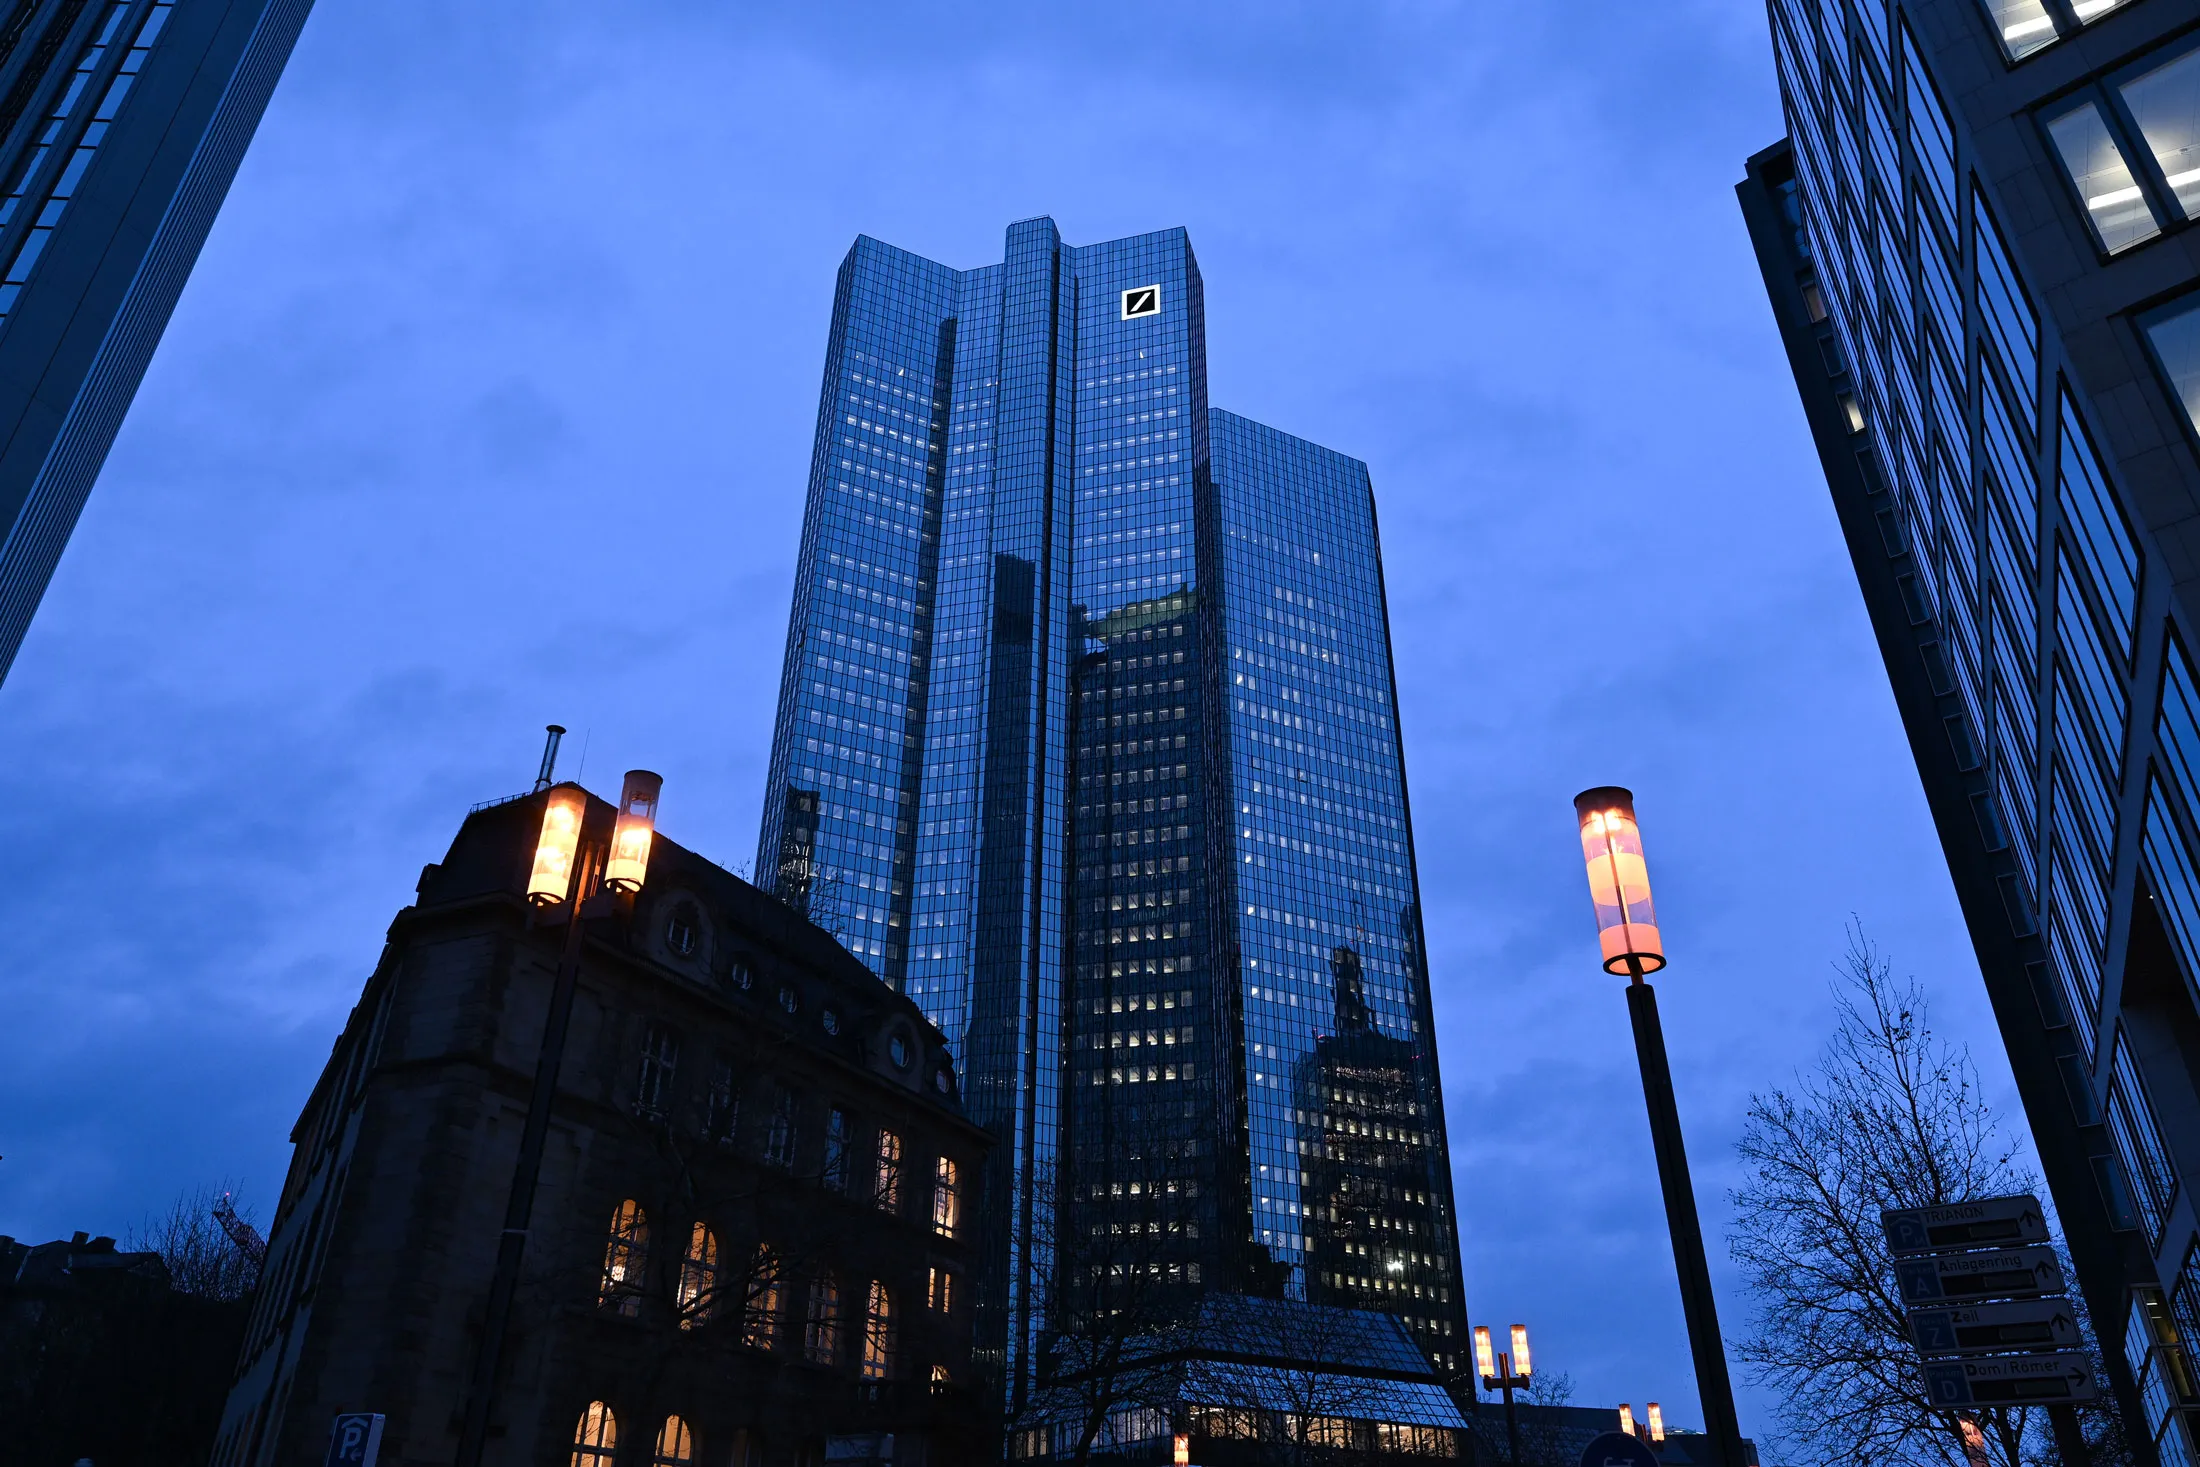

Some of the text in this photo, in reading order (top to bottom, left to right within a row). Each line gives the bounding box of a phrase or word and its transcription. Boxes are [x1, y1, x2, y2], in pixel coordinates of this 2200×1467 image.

[1925, 1207, 1984, 1223] TRIANON
[1939, 1255, 2022, 1272] Anlagenring
[1916, 1277, 1930, 1296] A
[1951, 1309, 1979, 1322] Zeil
[1927, 1328, 1945, 1347] Z
[1941, 1380, 1958, 1400] D
[338, 1427, 362, 1460] P
